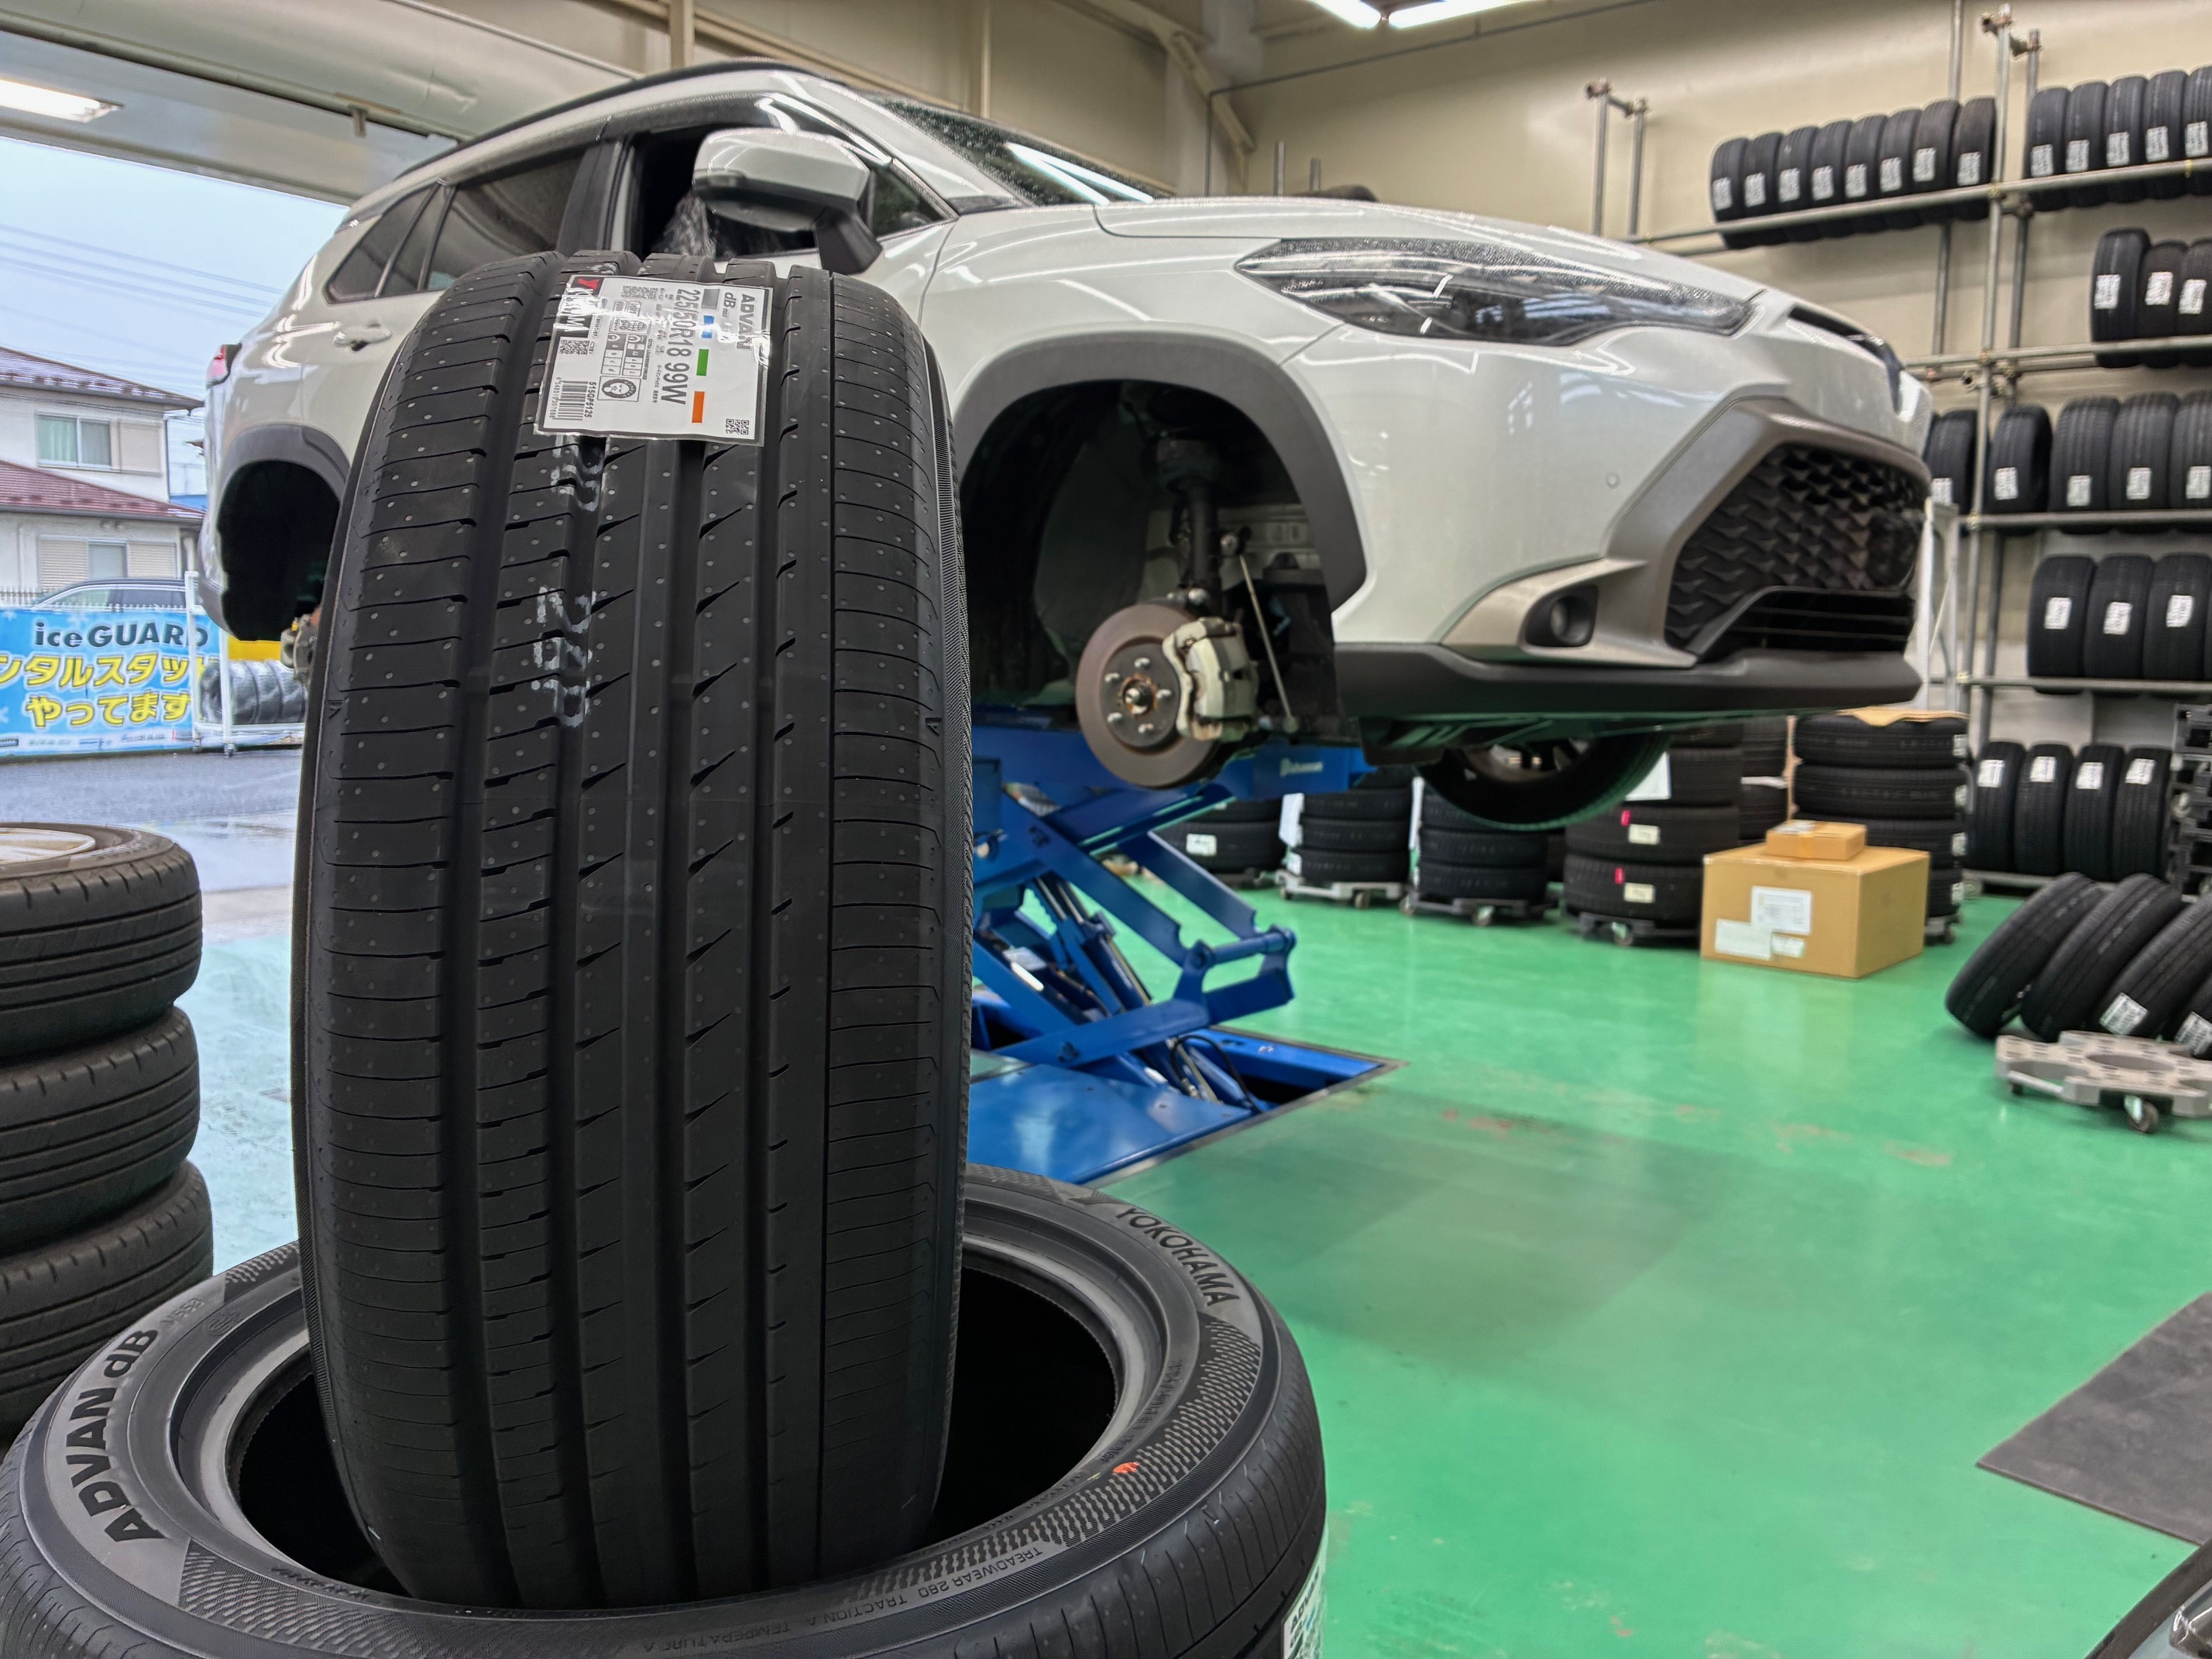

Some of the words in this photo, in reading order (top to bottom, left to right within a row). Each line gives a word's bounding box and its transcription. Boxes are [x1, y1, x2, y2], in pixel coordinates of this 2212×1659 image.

[723, 292, 737, 309] dB
[668, 288, 701, 357] 225/50R18
[736, 293, 756, 350] ADVAN
[584, 381, 597, 418] 515QP5125
[661, 362, 690, 405] 99W
[35, 622, 208, 647] iceGUARD
[26, 691, 192, 727] やってます
[1115, 1207, 1241, 1307] YOKOHAMA
[103, 1328, 159, 1379] dB
[66, 1387, 166, 1543] ADVAN
[952, 1547, 1042, 1587] TREADWEAR
[823, 1594, 908, 1624] TRACTION
[918, 1582, 950, 1599] 280
[663, 1623, 790, 1650] TEMPERATURE
